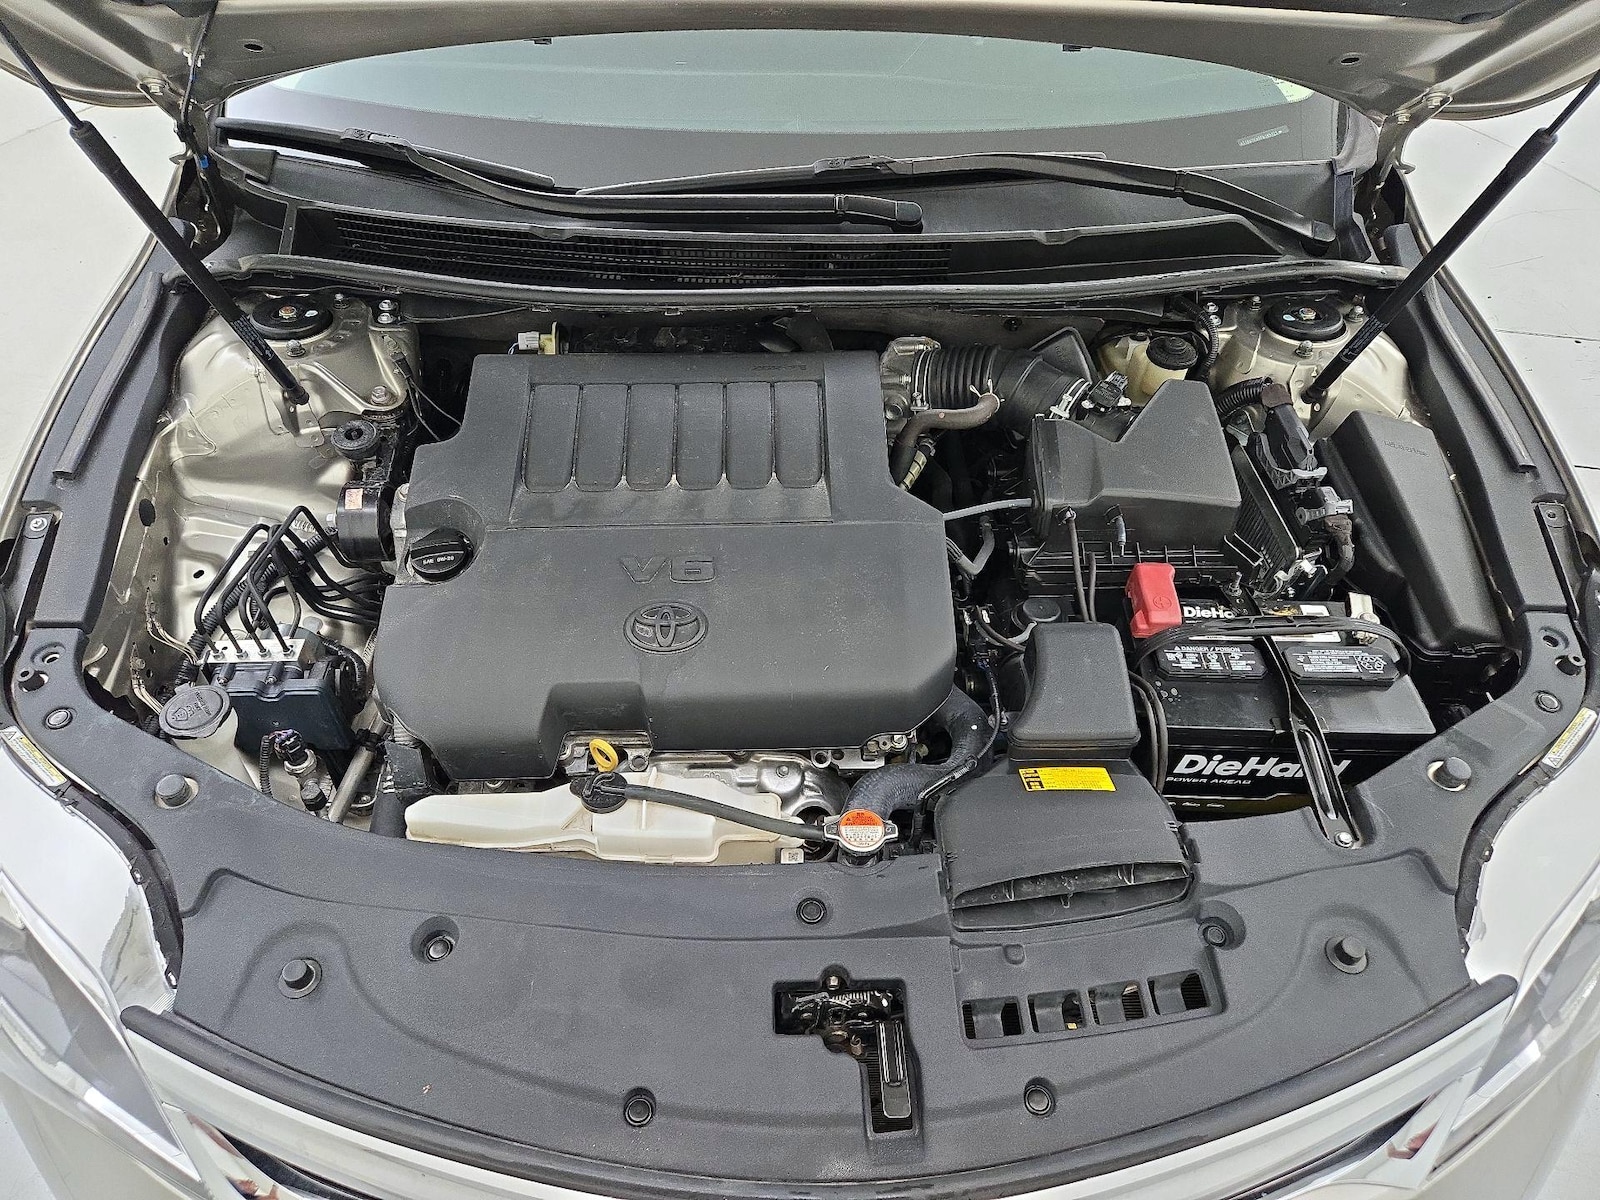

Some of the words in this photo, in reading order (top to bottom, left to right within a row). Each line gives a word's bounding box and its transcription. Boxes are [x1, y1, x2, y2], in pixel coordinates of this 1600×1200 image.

[619, 554, 717, 584] V6
[1183, 605, 1236, 620] DieHa
[1166, 776, 1208, 784] POWER
